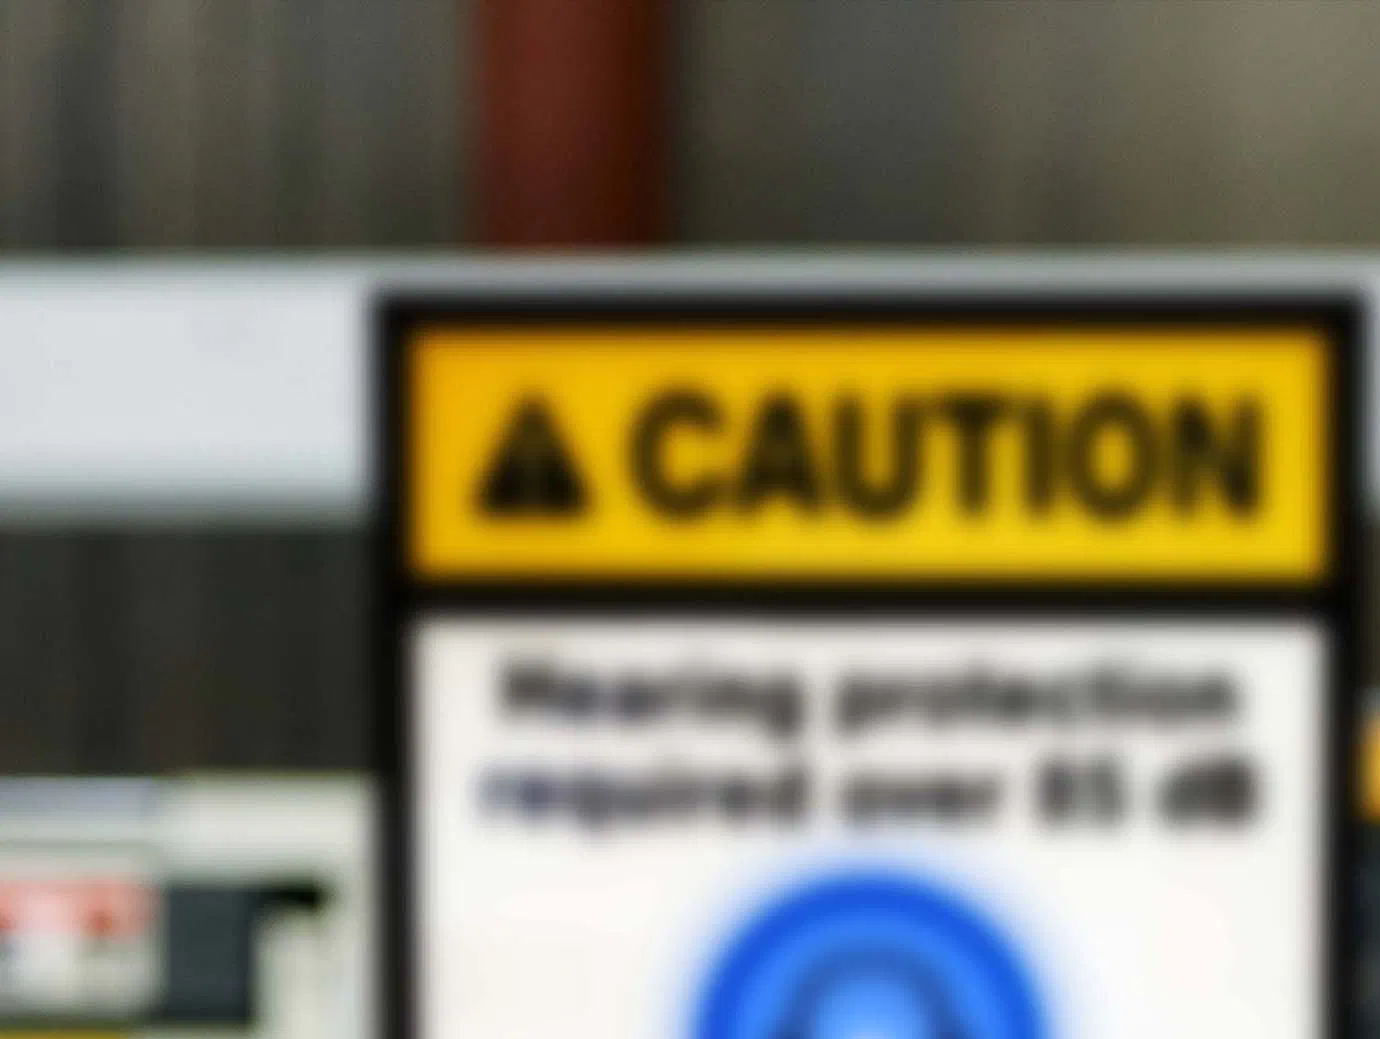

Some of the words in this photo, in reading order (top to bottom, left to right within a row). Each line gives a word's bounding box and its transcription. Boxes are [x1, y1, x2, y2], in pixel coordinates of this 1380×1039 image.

[628, 388, 1262, 524] CAUTION
[501, 661, 803, 740] Hearing
[835, 661, 1238, 739] protection
[476, 760, 806, 838] required
[842, 771, 1002, 828] over
[1158, 755, 1258, 829] dB
